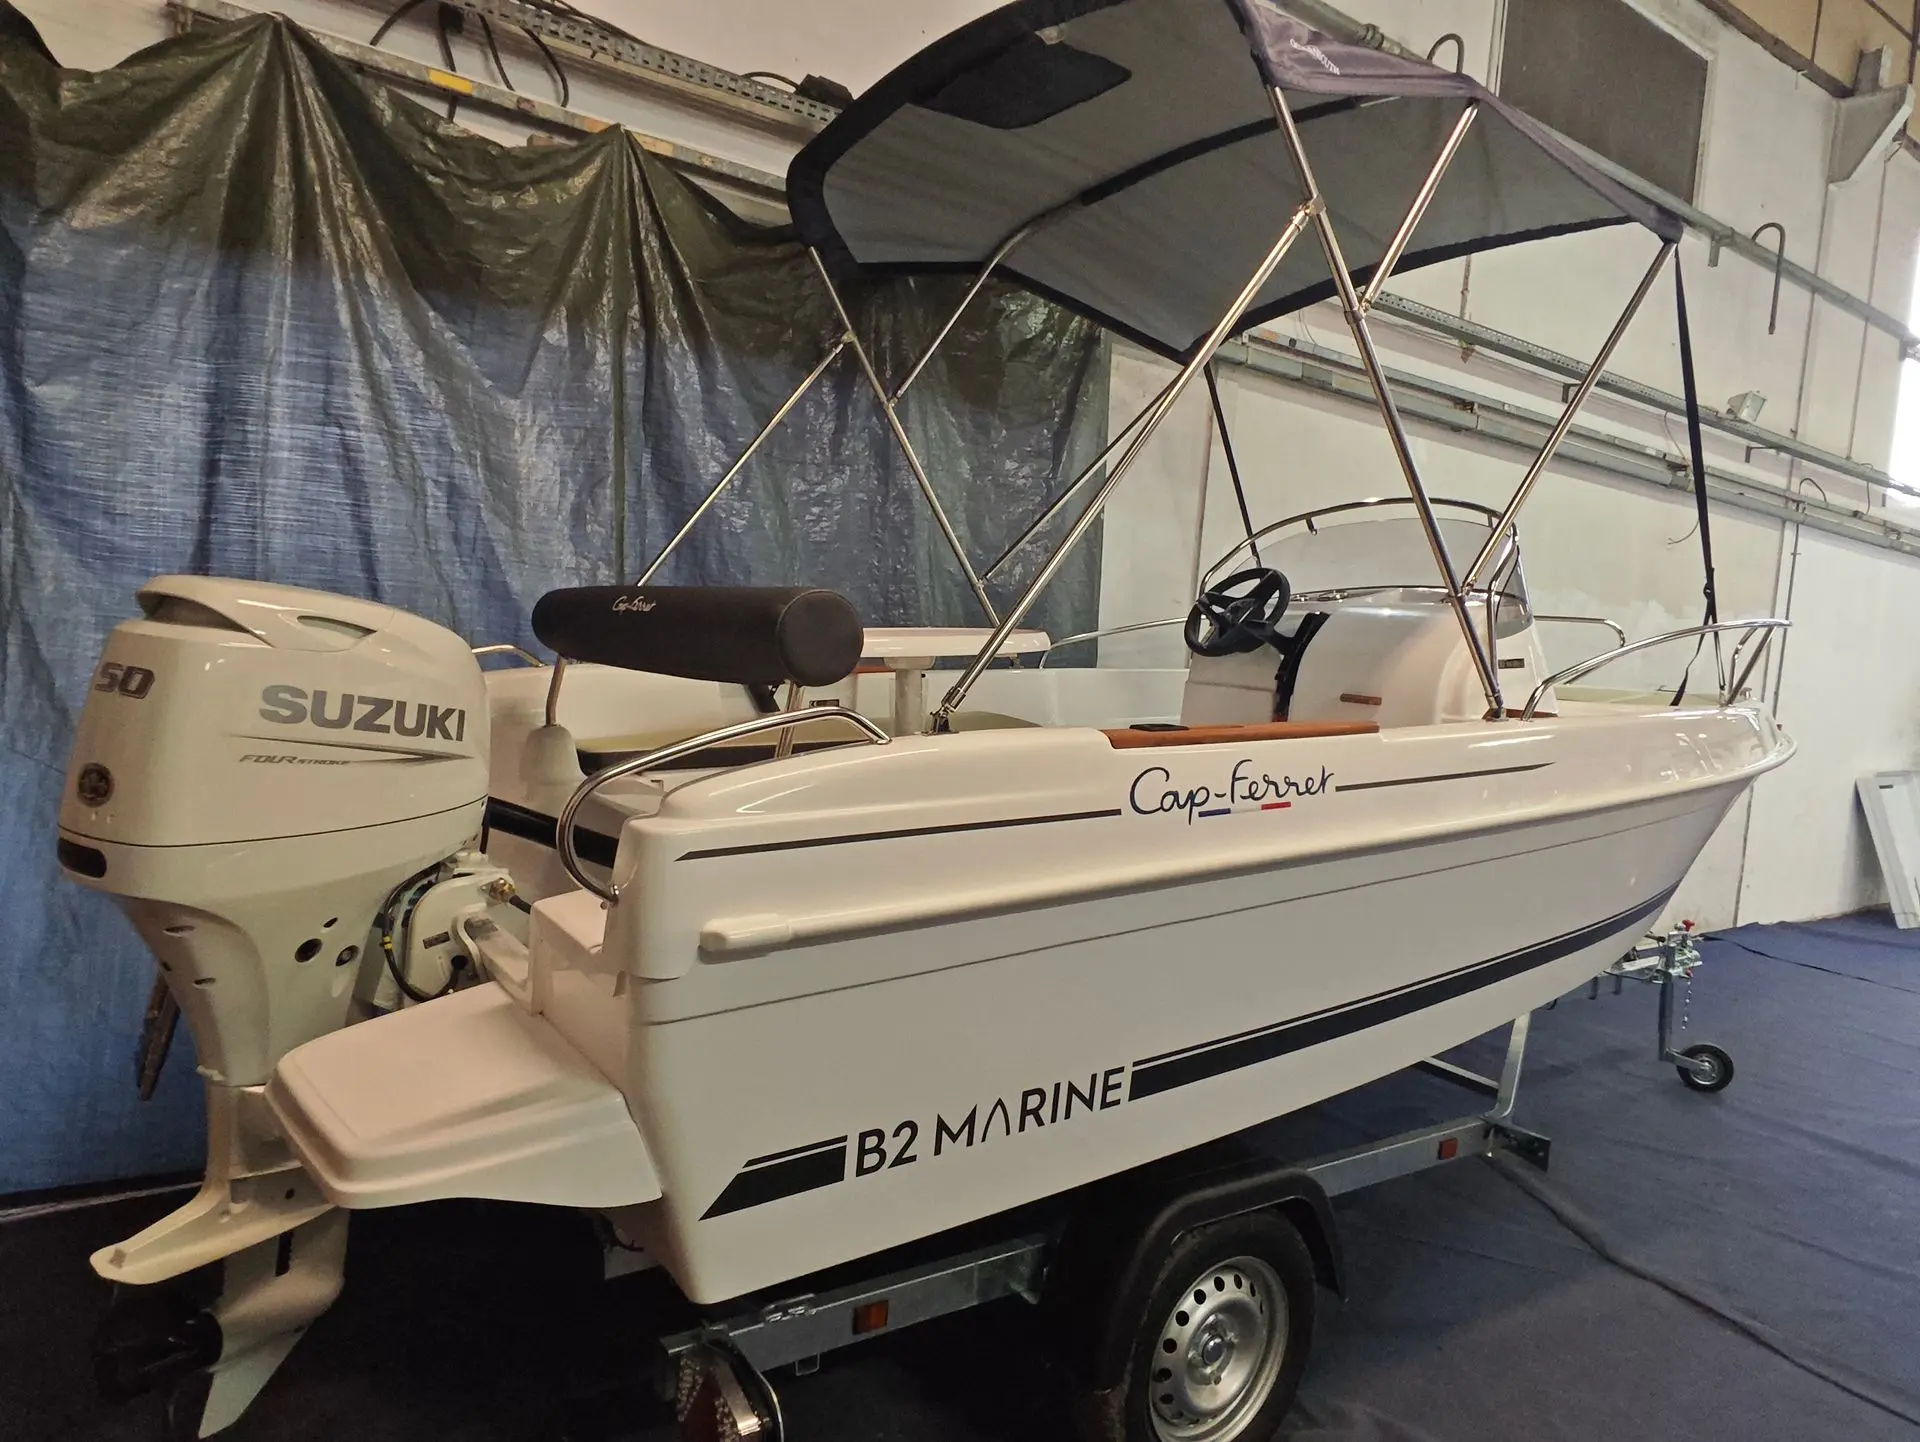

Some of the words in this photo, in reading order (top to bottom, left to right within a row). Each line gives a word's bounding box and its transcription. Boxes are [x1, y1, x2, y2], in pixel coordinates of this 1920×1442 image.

[95, 662, 156, 700] 50
[258, 684, 466, 742] SUZUKI
[239, 754, 298, 764] FOUR
[1129, 758, 1335, 826] Cap-Ferret
[855, 1119, 919, 1178] B2
[933, 1065, 1126, 1157] MARINE
